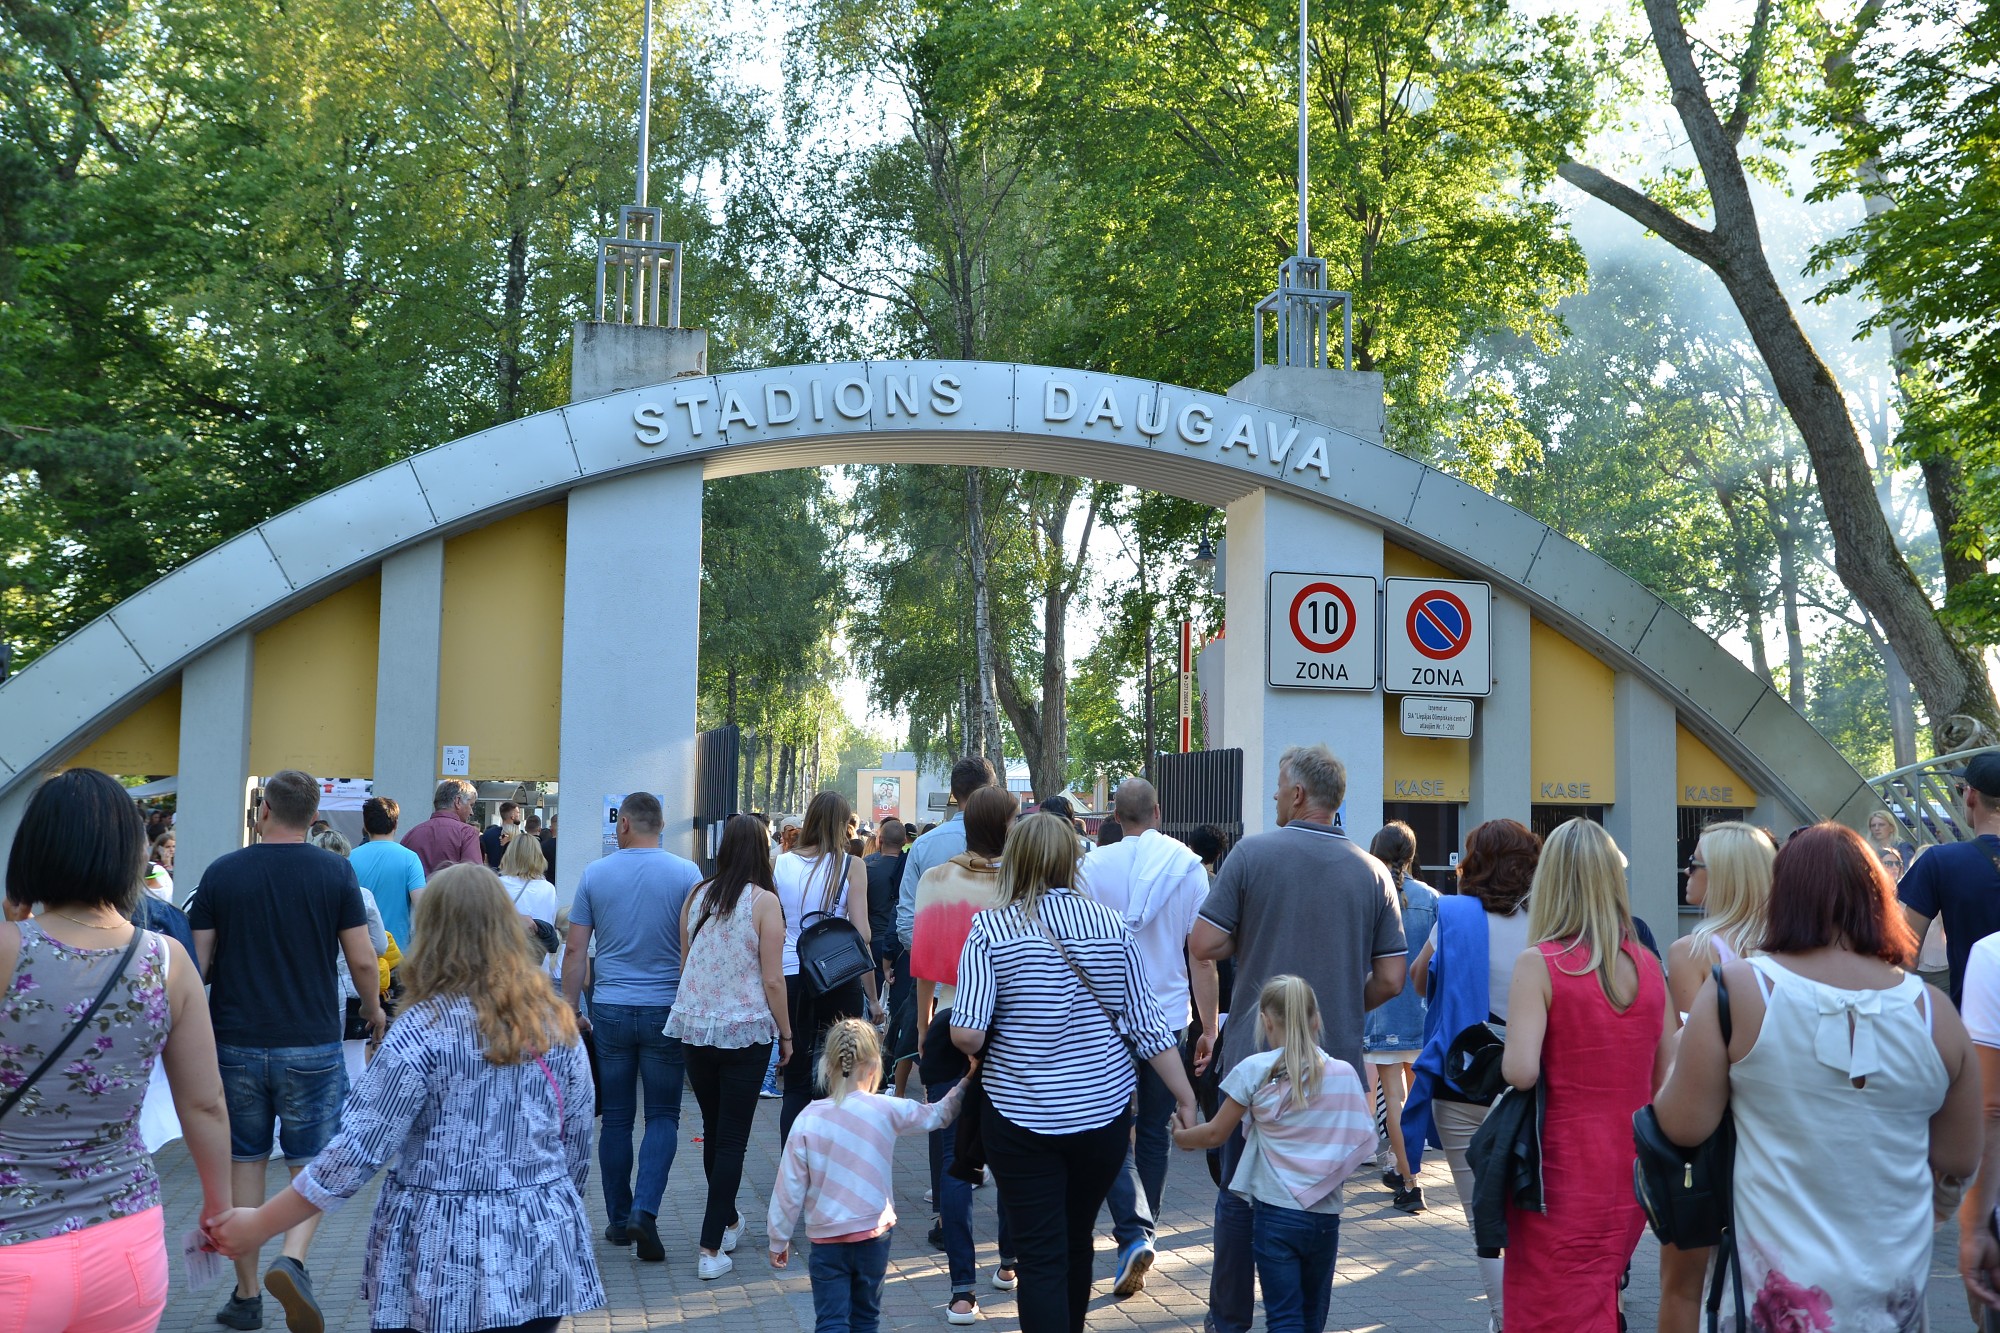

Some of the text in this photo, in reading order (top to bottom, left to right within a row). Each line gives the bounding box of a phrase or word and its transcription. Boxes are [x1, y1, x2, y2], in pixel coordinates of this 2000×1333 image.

[632, 373, 1331, 480] STADIONS DAUGAVA
[1308, 601, 1339, 635] 10
[1296, 662, 1349, 681] ZONA
[1411, 667, 1465, 687] ZONA
[1394, 779, 1445, 797] KASE
[1541, 782, 1592, 799] KASE
[1685, 785, 1733, 802] KASE
